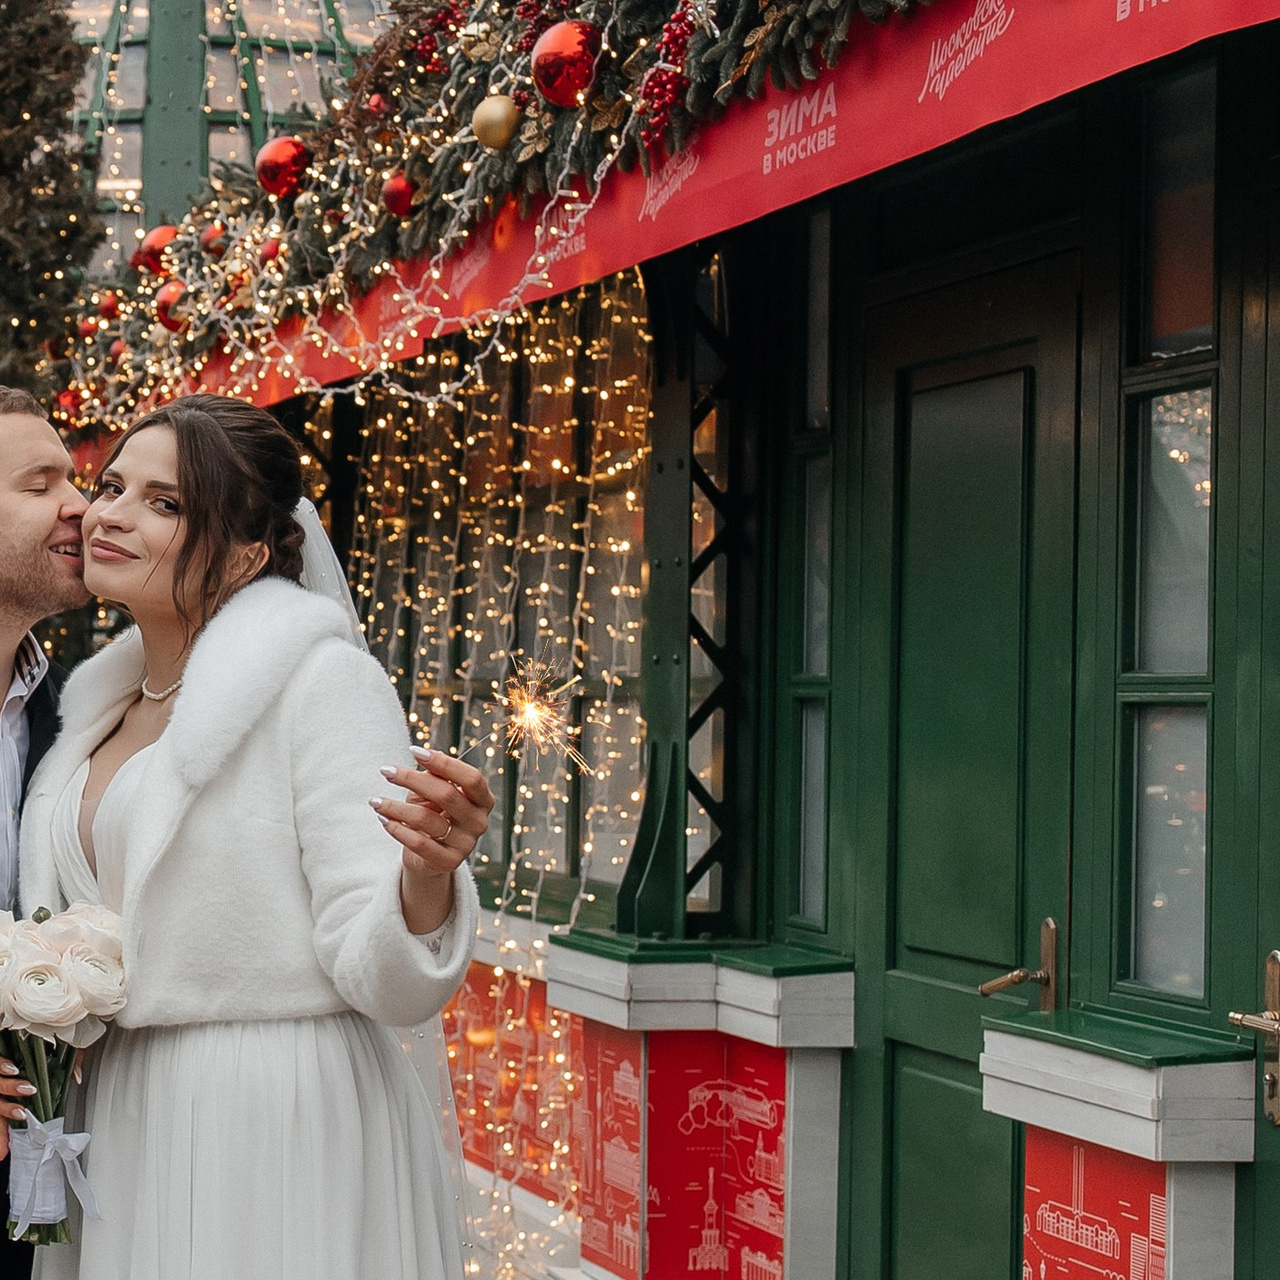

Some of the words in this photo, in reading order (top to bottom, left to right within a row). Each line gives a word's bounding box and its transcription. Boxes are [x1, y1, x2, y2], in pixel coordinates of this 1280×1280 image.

[764, 82, 837, 147] ЗИМА
[763, 153, 772, 175] В
[776, 124, 836, 170] МОСКВЕ
